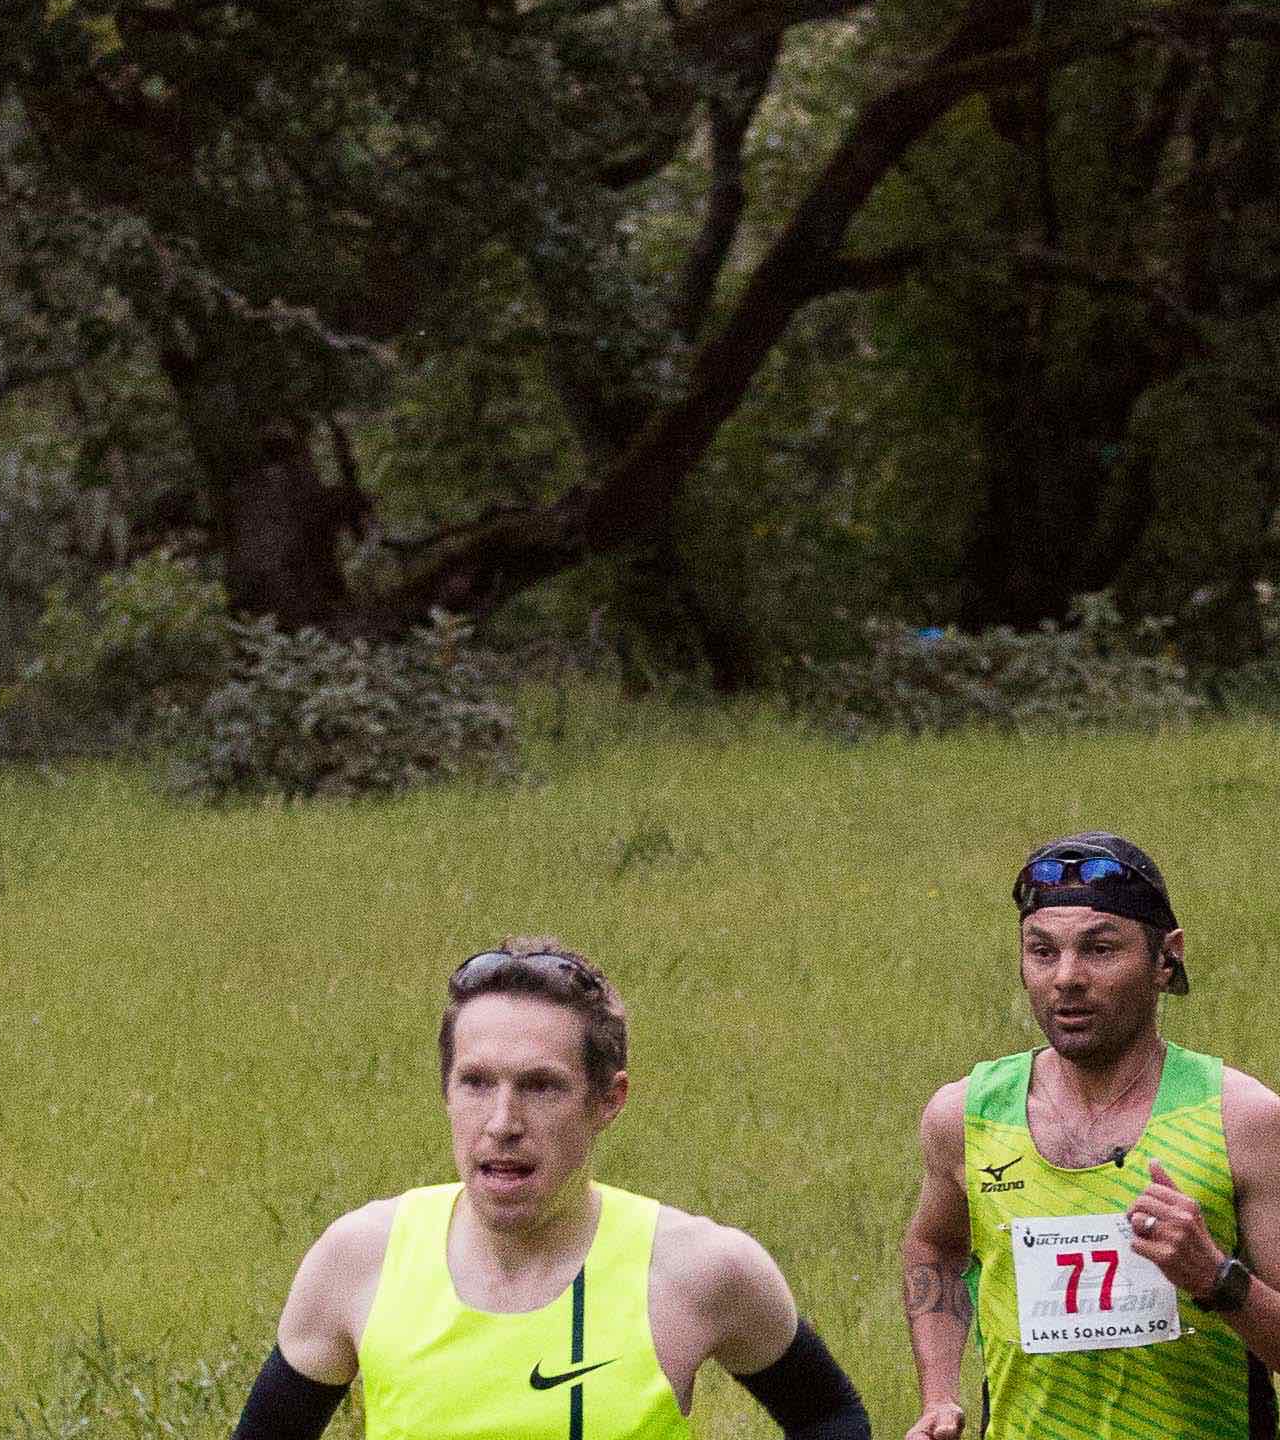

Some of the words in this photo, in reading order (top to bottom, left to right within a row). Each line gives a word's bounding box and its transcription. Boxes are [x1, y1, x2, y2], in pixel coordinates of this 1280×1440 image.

[1036, 1236, 1079, 1246] ULTRA
[1081, 1234, 1109, 1243] CUP
[1057, 1250, 1119, 1313] 77
[1031, 1329, 1068, 1341] LAKE
[1074, 1323, 1144, 1338] SONOMA
[1149, 1320, 1168, 1332] 50
